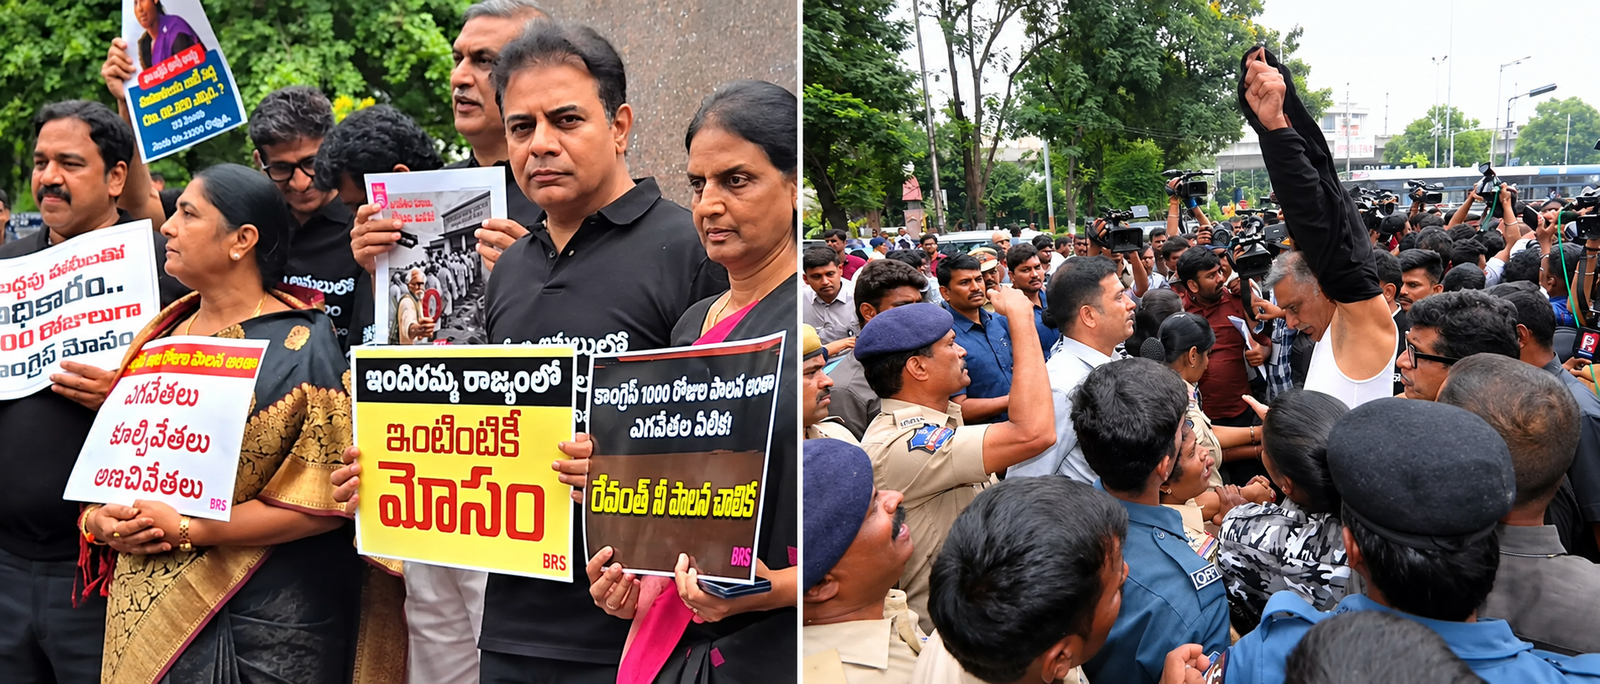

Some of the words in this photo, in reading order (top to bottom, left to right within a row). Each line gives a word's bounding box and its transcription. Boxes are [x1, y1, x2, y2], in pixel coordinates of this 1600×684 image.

[62, 330, 134, 358] మోసం
[124, 376, 199, 407] ఎగవేతలు
[365, 363, 460, 404] ఇందిరమ్మ
[463, 359, 562, 405] రాజ్యంలో
[641, 384, 670, 404] 1000
[709, 373, 745, 400] పాలన
[386, 409, 522, 458] ఇంటింటికీ
[630, 410, 692, 438] ఎగవేతల
[94, 461, 203, 499] అణచివేతలు
[591, 474, 651, 515] రేవంత్
[652, 479, 667, 515] నీ
[669, 481, 711, 517] పాలన
[209, 498, 227, 511] BRS
[378, 461, 545, 542] మోసం
[543, 553, 567, 571] BRS
[730, 547, 751, 567] BRS
